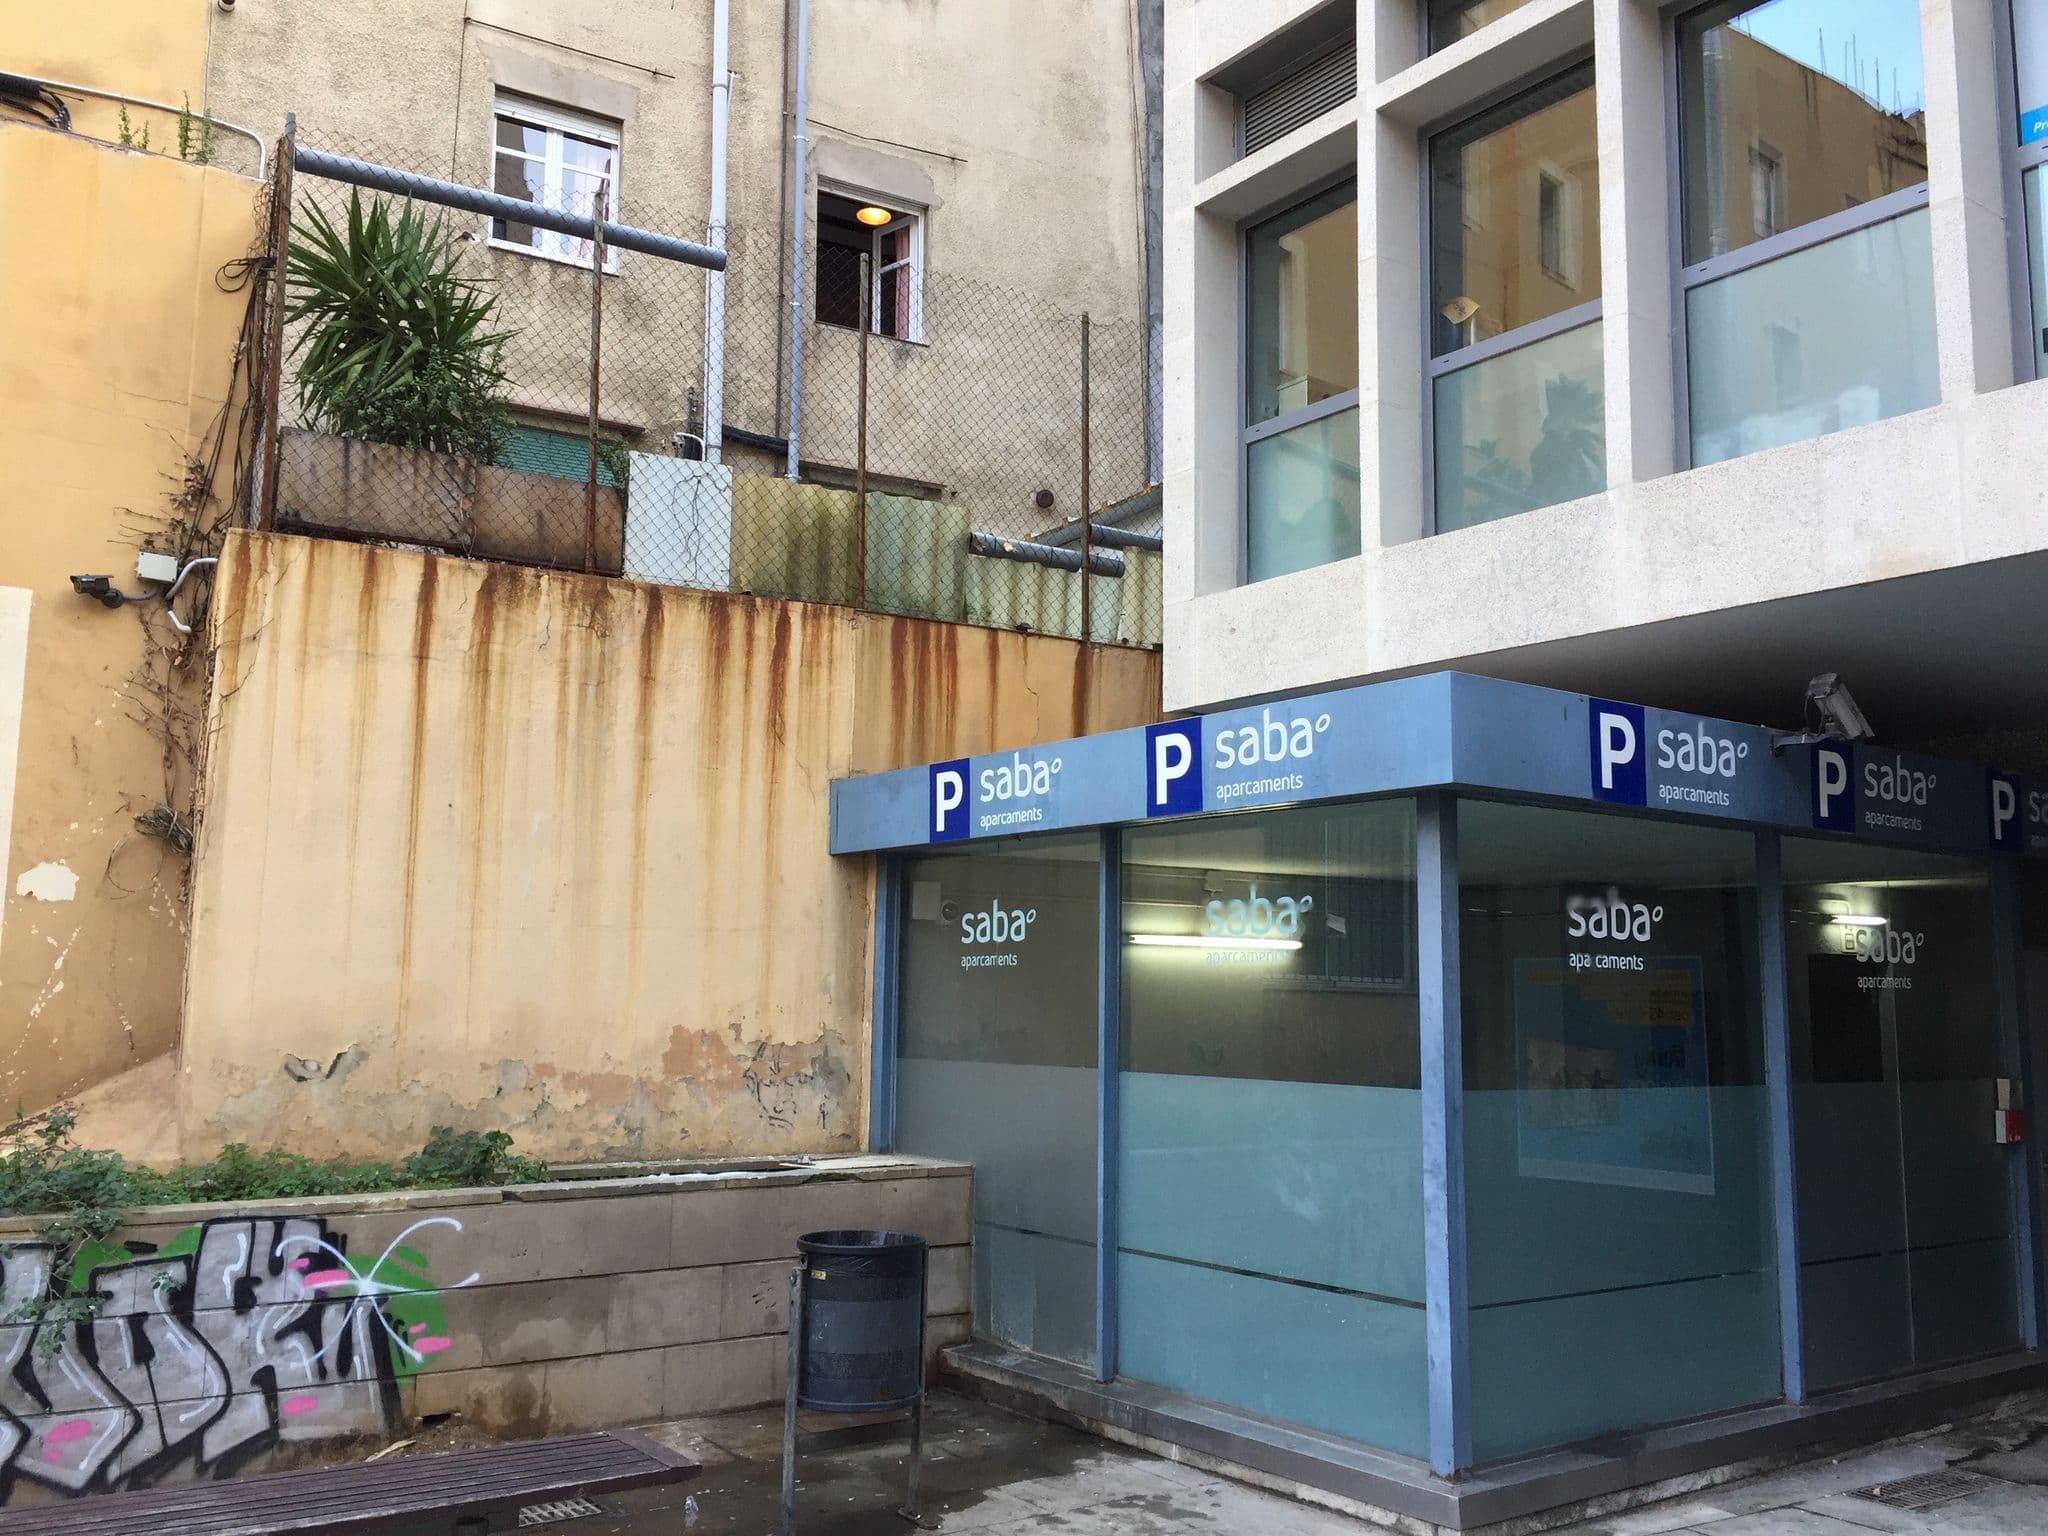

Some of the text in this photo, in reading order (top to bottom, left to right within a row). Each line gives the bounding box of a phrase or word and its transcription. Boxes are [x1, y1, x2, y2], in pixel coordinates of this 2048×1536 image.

[1600, 712, 1636, 789] P
[1155, 732, 1193, 806] P
[1818, 750, 1848, 818] P
[936, 769, 963, 833] P
[1215, 772, 1304, 802] aparcaments
[1659, 782, 1730, 806] aparcaments
[980, 806, 1043, 829] aparcaments
[1865, 810, 1923, 831] aparcaments
[1992, 779, 2016, 840] P
[1569, 951, 1644, 973] apacaments
[1857, 974, 1912, 992] aparcaments
